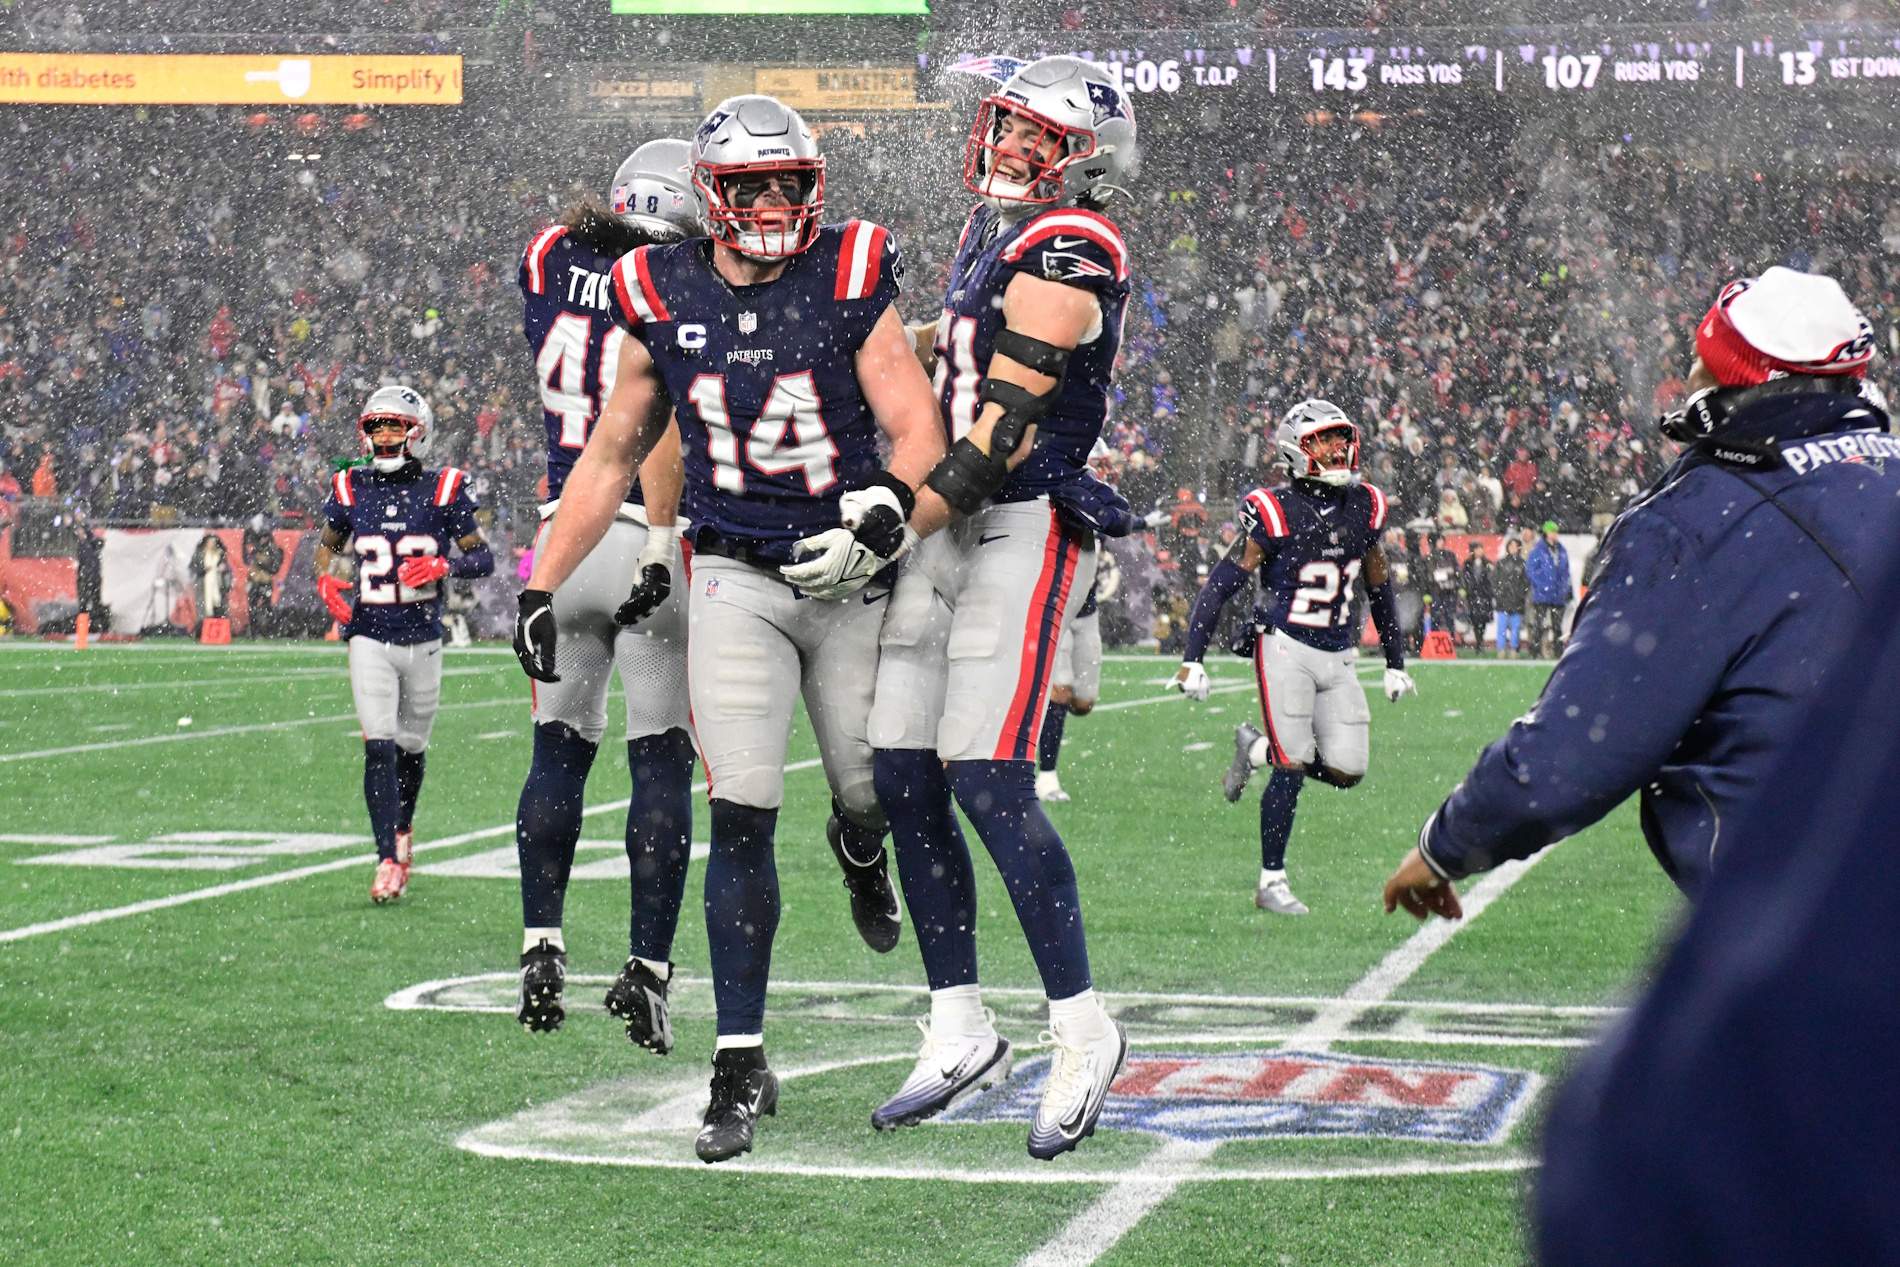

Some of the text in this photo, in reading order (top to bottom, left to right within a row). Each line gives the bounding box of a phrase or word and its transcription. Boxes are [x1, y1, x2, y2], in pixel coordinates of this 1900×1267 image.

[37, 66, 137, 88] diabetes
[352, 68, 447, 94] Simplify
[1309, 57, 1462, 91] 143 PASS YDS
[1542, 54, 1699, 89] 107 RUSH YDS
[1779, 51, 1816, 85] 13
[1829, 57, 1861, 78] 1ST
[758, 147, 791, 158] PATRIOTS
[677, 324, 707, 349] C
[726, 349, 774, 364] PATRIOTS
[688, 369, 839, 496] 14
[354, 535, 439, 604] 22
[1287, 558, 1362, 627] 21
[1431, 635, 1454, 655] 20
